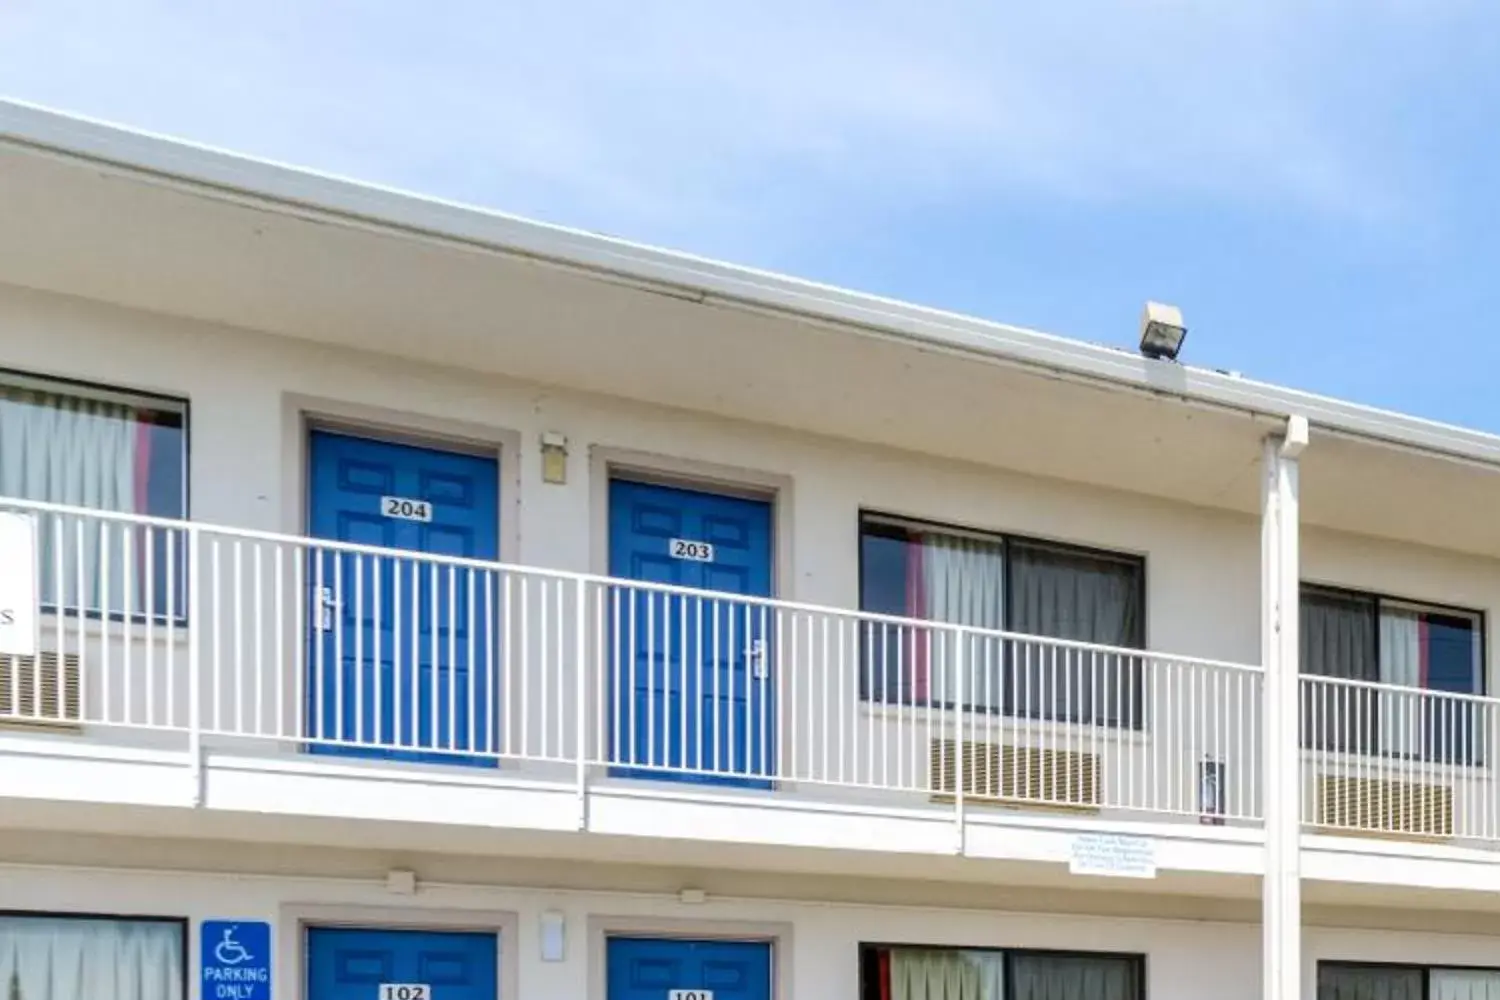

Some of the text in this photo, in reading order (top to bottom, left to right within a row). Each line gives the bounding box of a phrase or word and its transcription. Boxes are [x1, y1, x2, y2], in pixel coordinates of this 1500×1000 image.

[388, 499, 427, 518] 204
[675, 541, 709, 559] 203
[204, 966, 268, 983] PARKING
[216, 983, 254, 1000] ONLY
